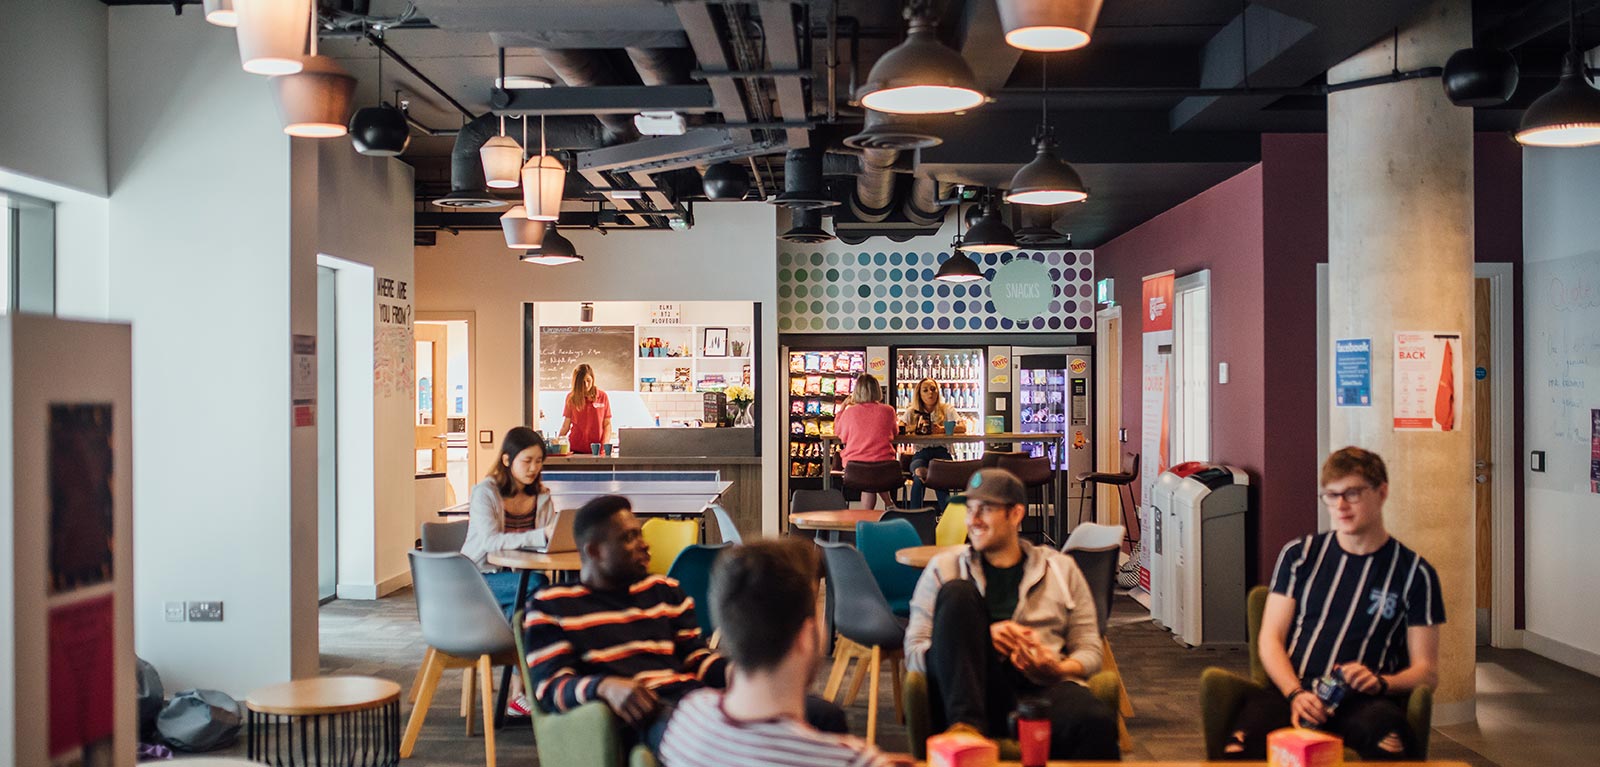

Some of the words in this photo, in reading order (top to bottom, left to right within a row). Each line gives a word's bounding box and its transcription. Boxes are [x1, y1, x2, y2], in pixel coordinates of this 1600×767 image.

[377, 277, 394, 298] WHERE
[397, 281, 407, 300] ARE
[1006, 282, 1040, 298] SNACKS
[379, 303, 390, 323] YOU
[992, 357, 1009, 368] TAYTO
[1399, 352, 1426, 360] BACK
[1070, 361, 1087, 372] TAYTO
